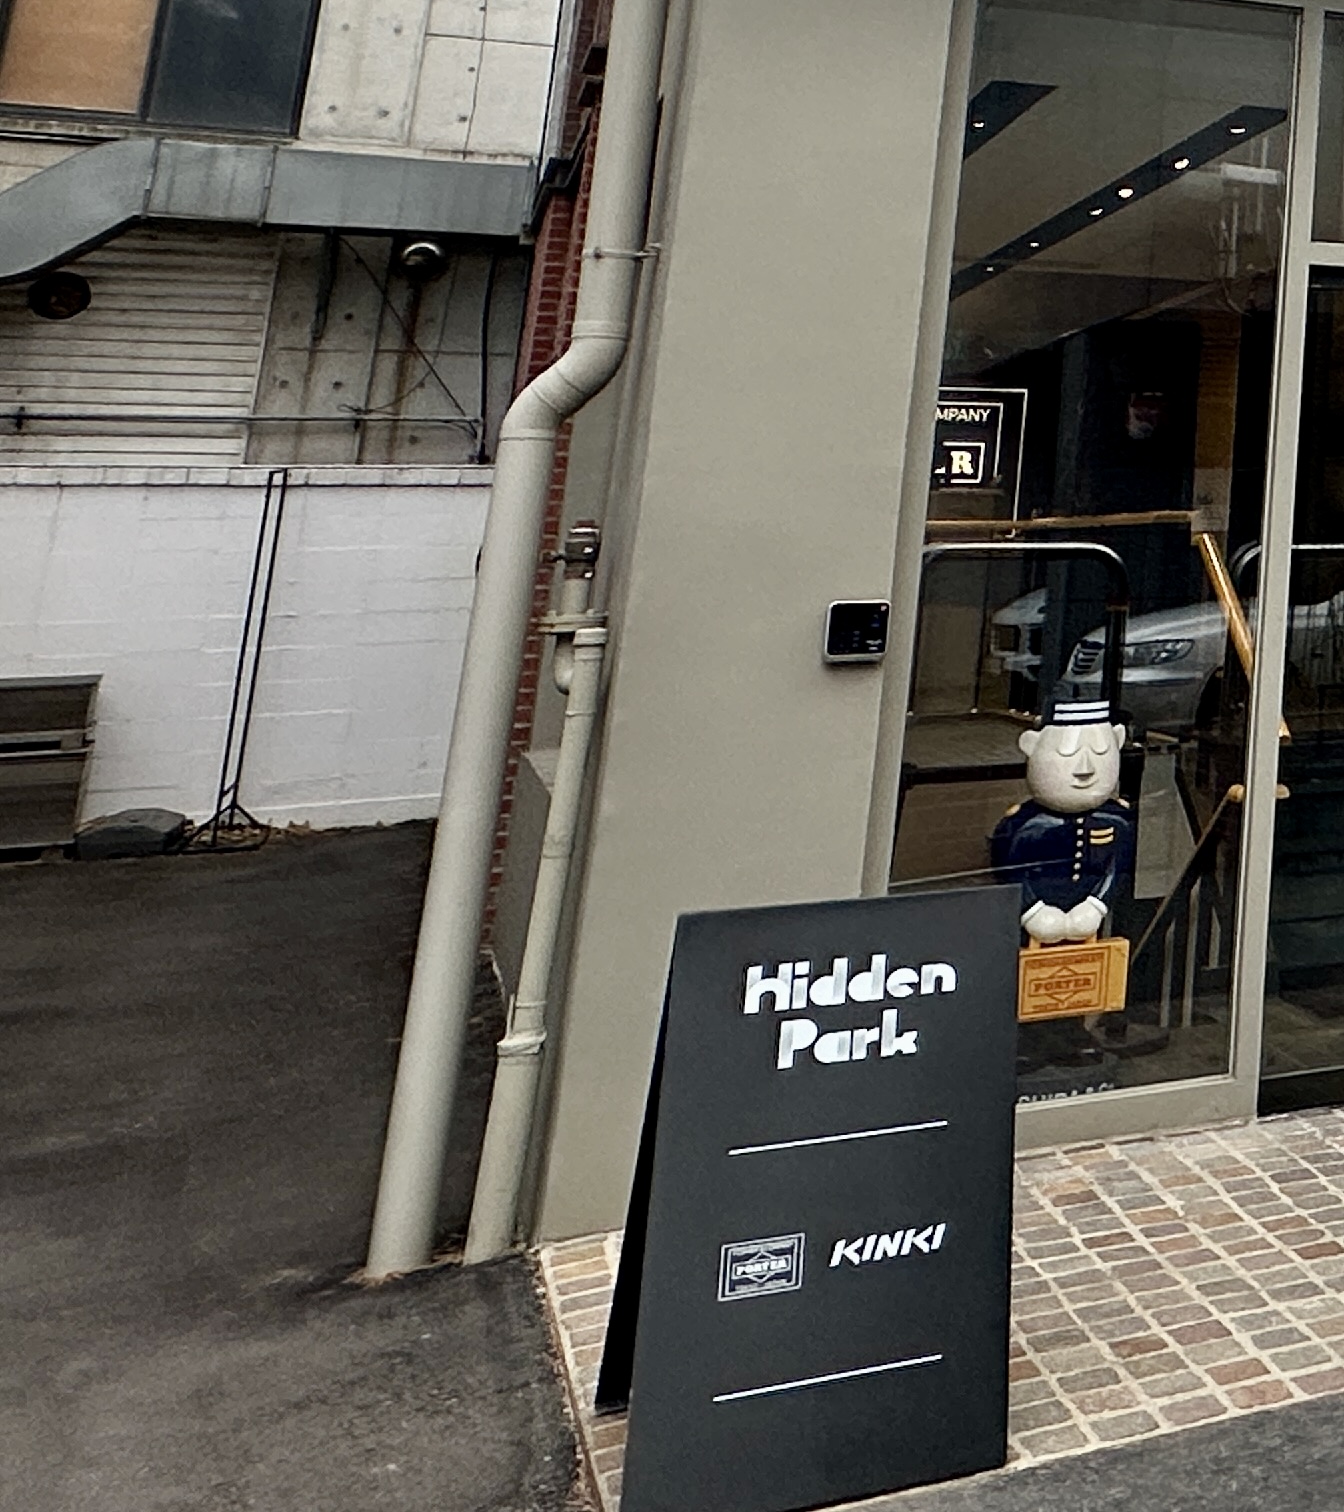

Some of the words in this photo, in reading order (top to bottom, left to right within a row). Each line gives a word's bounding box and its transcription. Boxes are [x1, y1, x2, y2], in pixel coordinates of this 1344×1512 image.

[742, 954, 958, 1015] Hidden
[775, 1008, 920, 1070] Park
[829, 1222, 947, 1268] KINKI
